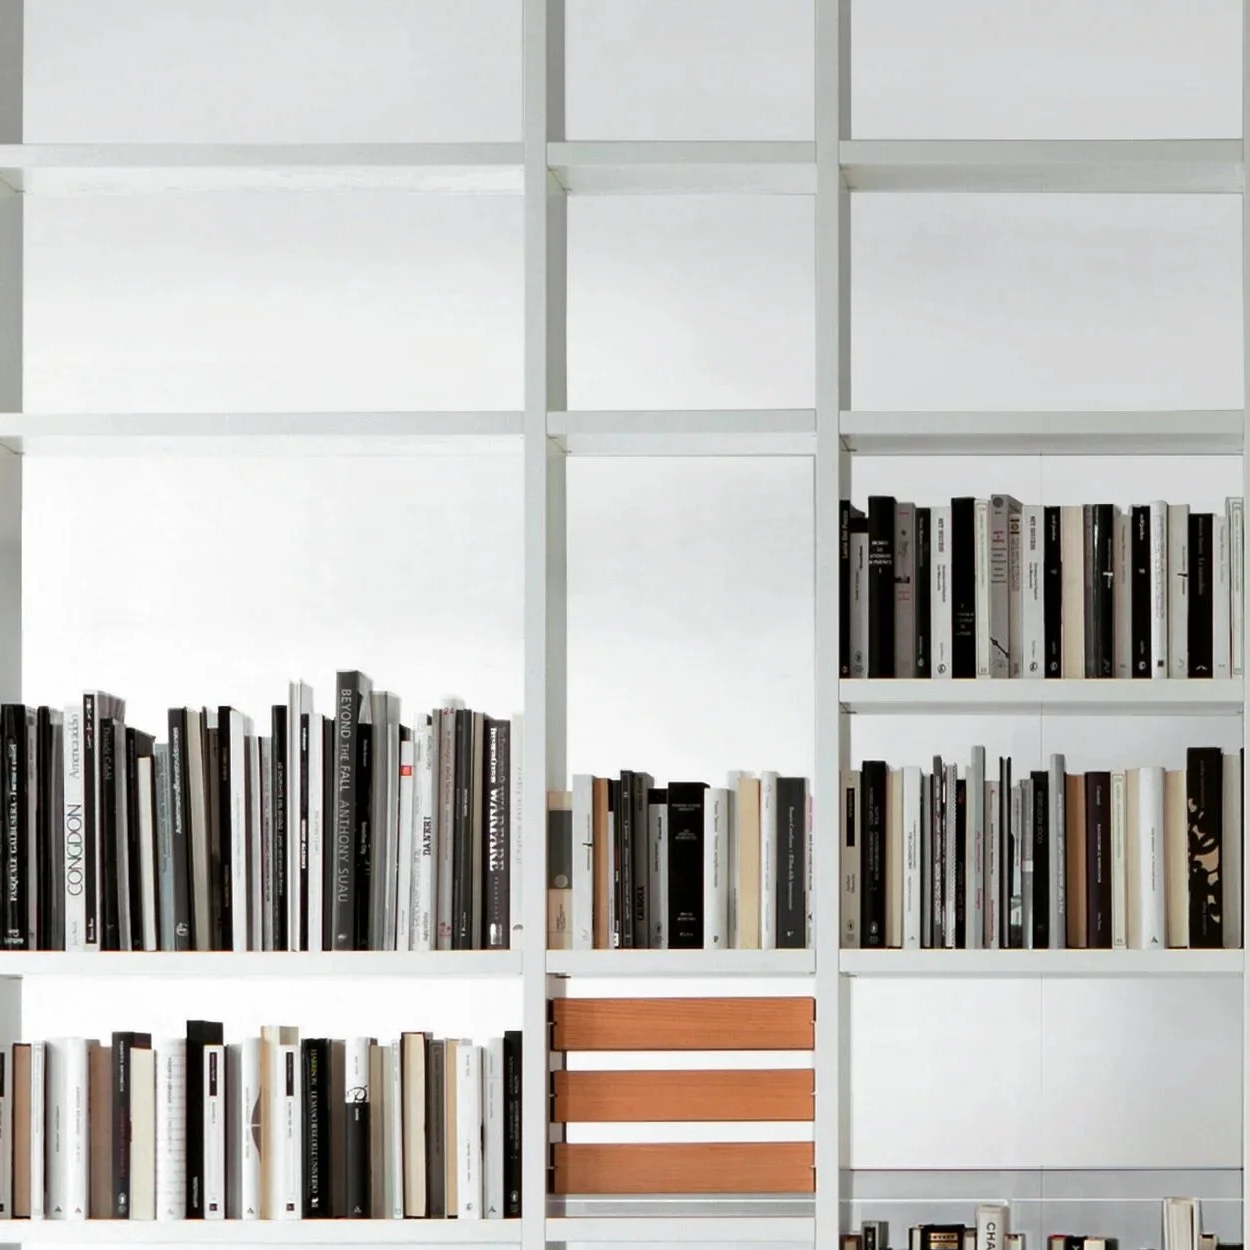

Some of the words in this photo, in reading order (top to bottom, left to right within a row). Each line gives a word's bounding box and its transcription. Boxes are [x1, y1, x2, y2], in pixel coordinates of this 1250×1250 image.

[340, 689, 353, 739] BEYOND
[68, 739, 81, 780] America
[340, 744, 350, 761] THE
[339, 766, 352, 793] FALL
[66, 804, 83, 896] CONGDON
[338, 800, 350, 862] ANTHONY
[489, 786, 506, 872] WARFARE
[9, 857, 19, 902] PASQUALE
[337, 868, 350, 903] SUAU
